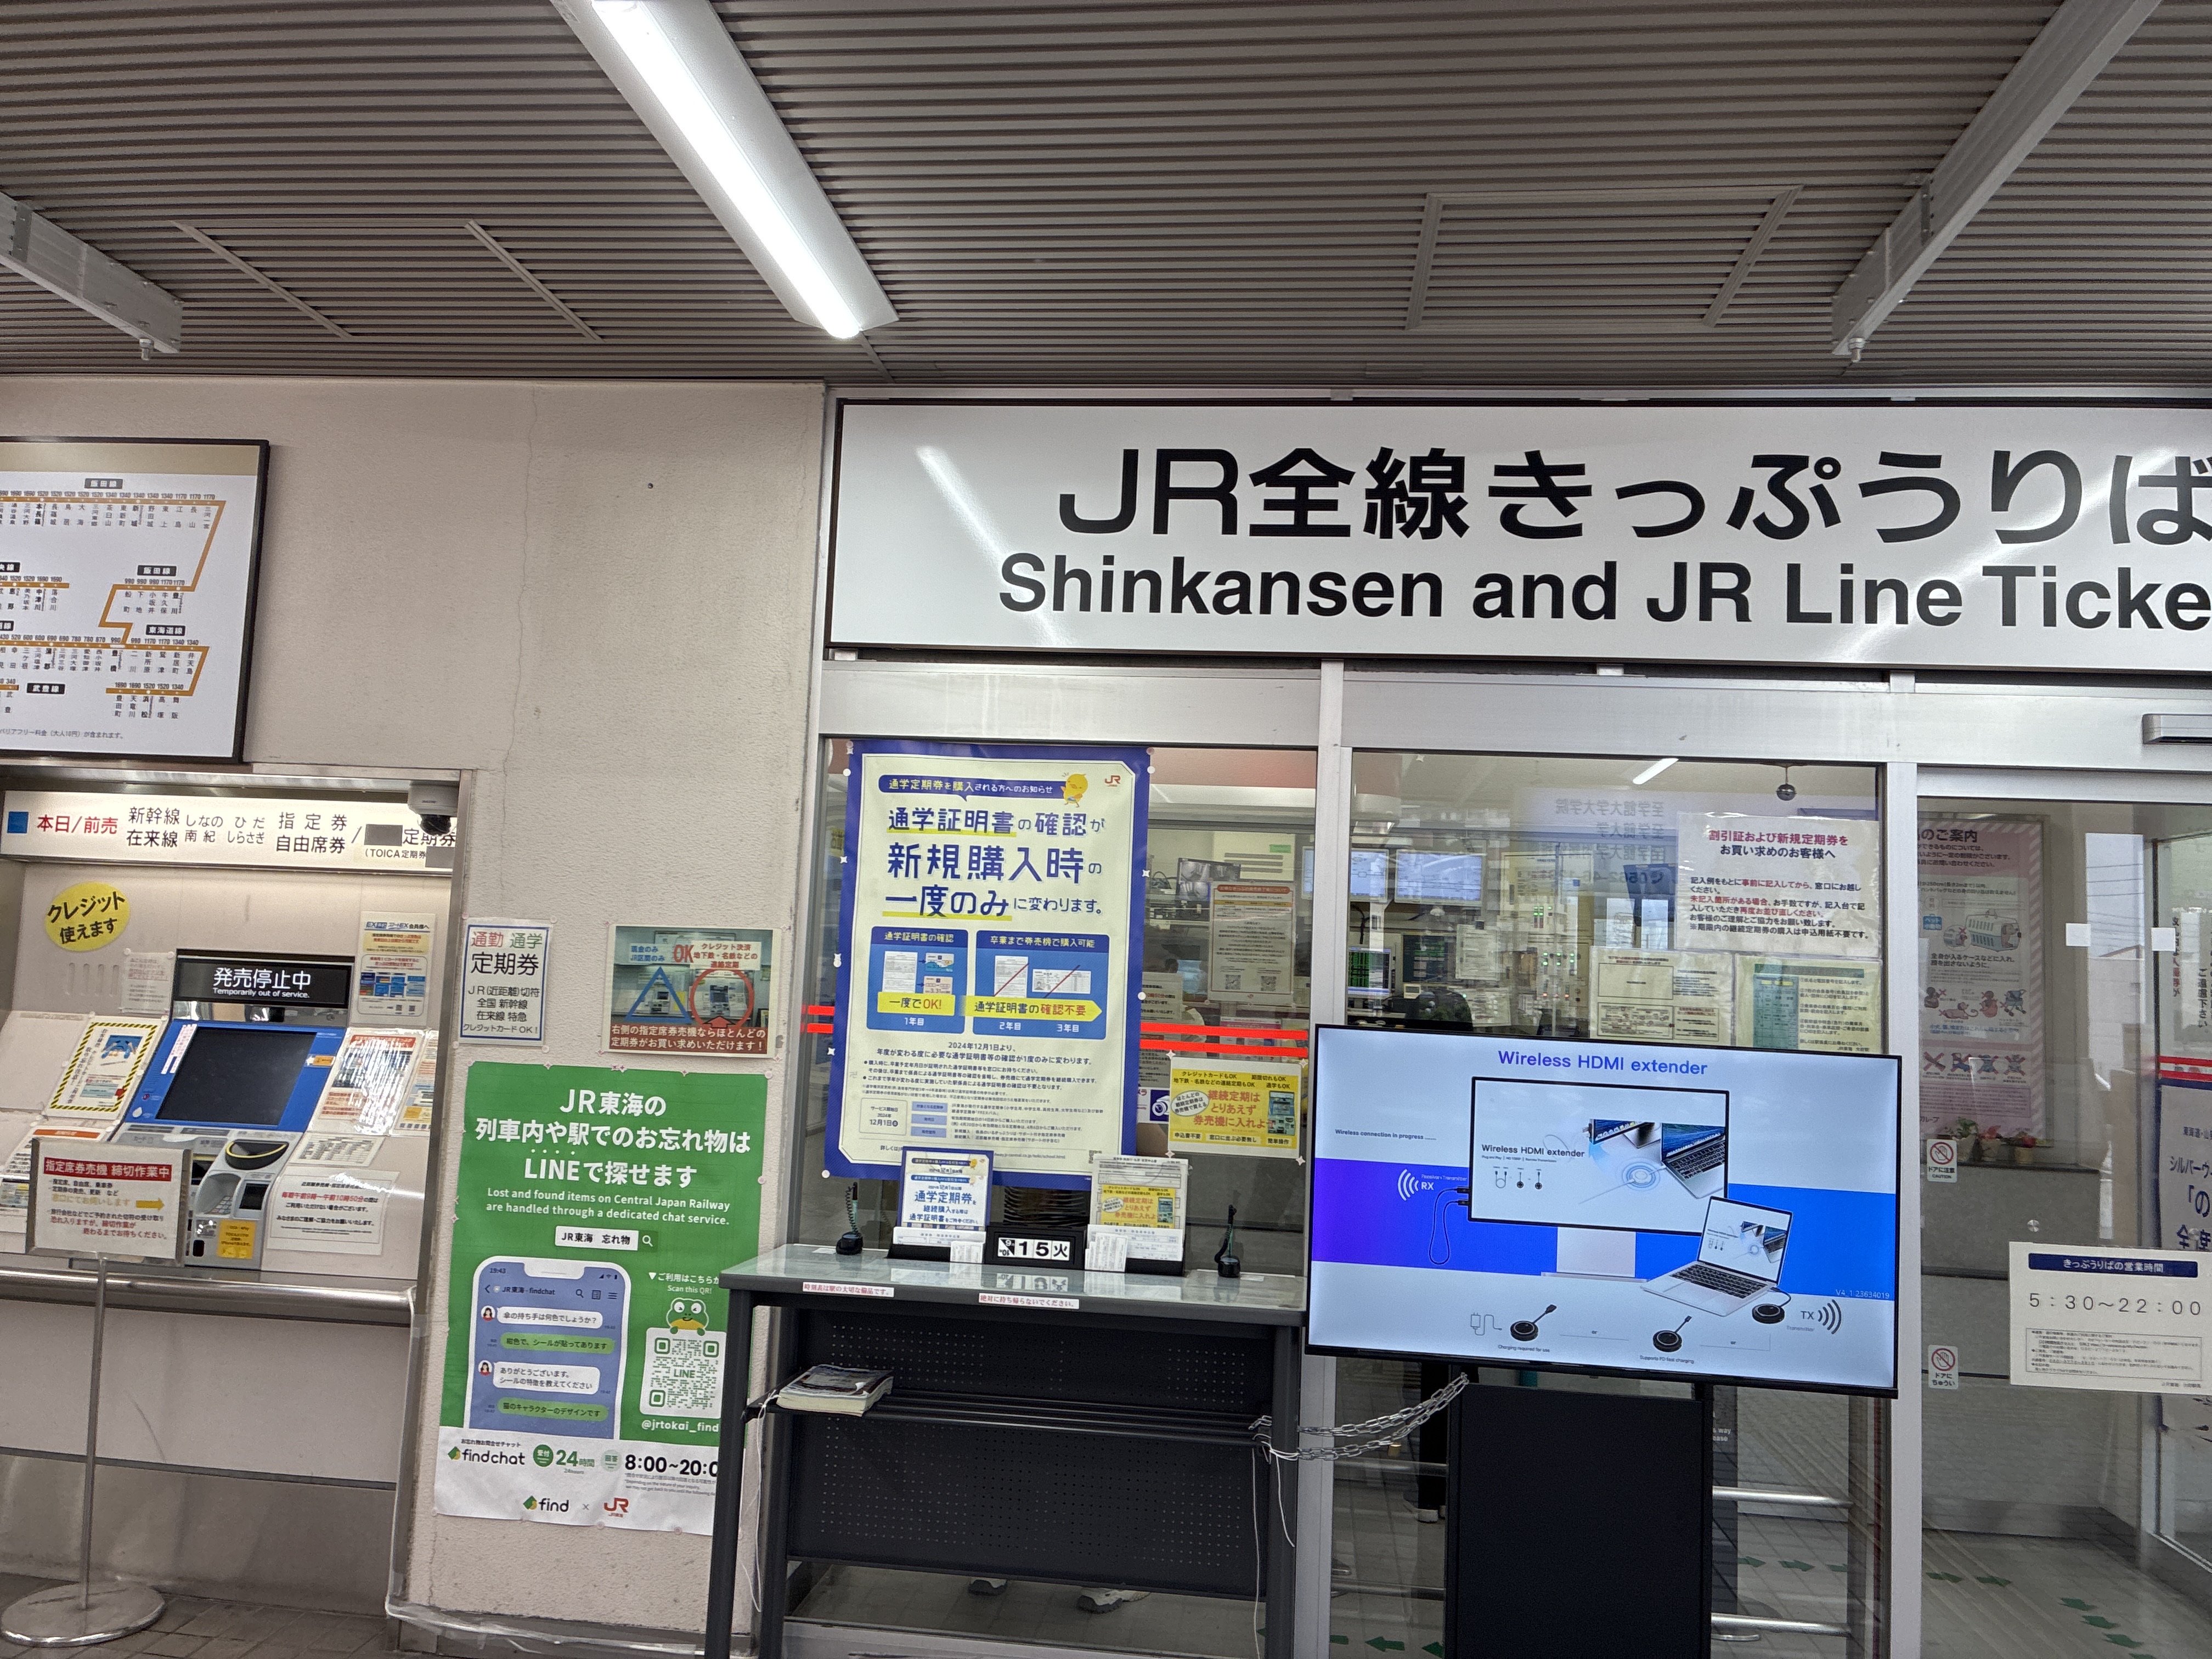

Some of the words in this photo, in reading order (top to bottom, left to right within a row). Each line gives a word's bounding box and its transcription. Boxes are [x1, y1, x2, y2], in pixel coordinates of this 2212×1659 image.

[1059, 447, 2212, 545] JR全線きっぷうりば
[999, 552, 1443, 617] Shinkansen
[1472, 560, 1617, 621] and
[1646, 561, 1752, 623] JR
[1786, 563, 1963, 627] Line
[1982, 565, 2212, 631] Ticke
[888, 777, 1053, 795] 通学定期券を購入される方へのお知らせ
[128, 806, 180, 826] 新幹線
[185, 814, 224, 828] しなの
[278, 811, 348, 832] 指定券
[888, 806, 1106, 837] 通学証明書の確認が
[126, 829, 178, 849] 在来線
[184, 830, 216, 843] 南紀
[226, 830, 266, 845] しらさぎ
[275, 833, 347, 855] 自由席券
[1708, 830, 1849, 847] 割引証および新規定期券を
[1918, 828, 1978, 843] のご案内
[1720, 844, 1836, 860] お買い求めのお客様へ
[887, 841, 1103, 885] 新規購入時の
[46, 890, 126, 924] クレジット
[884, 883, 1103, 918] 一度のみに変わります。
[60, 917, 119, 945] 使えます
[470, 930, 504, 948] 通勤
[509, 932, 543, 949] 通学
[884, 931, 955, 944] 通学証明書の確認
[990, 935, 1096, 949] 卒業まで券売機で購入可能
[673, 944, 695, 963] OK
[701, 943, 752, 952] クレジット決済
[470, 951, 540, 977] 定期券
[212, 967, 312, 991] 発売停止中
[212, 987, 256, 997] Temporarily
[273, 990, 280, 998] of
[282, 991, 311, 999] service.
[477, 997, 496, 1008] 全国
[498, 998, 528, 1010] 新幹線
[974, 1001, 1086, 1017] 通学証明書の確認不要
[476, 1010, 506, 1022] 在来線
[507, 1011, 528, 1023] 特急
[904, 1017, 925, 1026] 1年目
[463, 1023, 517, 1034] クレジットカード
[611, 1024, 766, 1039] 右側の指定席券売機ならほとんどの
[998, 1021, 1022, 1031] 2年目
[1057, 1023, 1080, 1033] 3年目
[1498, 1050, 1572, 1069] Wireless
[1577, 1054, 1624, 1071] HDMI
[1630, 1059, 1708, 1076] extender
[558, 1088, 667, 1117] JR東海の
[1207, 1090, 1261, 1103] 継続定期は
[1210, 1103, 1257, 1115] とりあえず
[474, 1117, 752, 1154] 列車内や駅でのお忘れ物は
[1481, 1144, 1518, 1154] Wireless
[1521, 1146, 1544, 1155] HDMI
[1547, 1149, 1585, 1158] extender
[44, 1159, 109, 1176] 指定席券売機
[111, 1164, 170, 1178] 締切作業中
[523, 1158, 698, 1189] LINEで探せます
[1420, 1181, 1435, 1191] RX
[487, 1186, 510, 1198] Lost
[511, 1188, 532, 1200] and
[533, 1189, 566, 1201] found
[567, 1190, 596, 1203] items
[597, 1195, 612, 1204] on
[613, 1193, 653, 1207] Central
[654, 1196, 687, 1210] Japan
[689, 1198, 731, 1213] Railway
[486, 1204, 504, 1212] are
[505, 1201, 550, 1215] handled
[551, 1204, 595, 1220] through
[597, 1209, 604, 1218] a
[606, 1206, 660, 1222] dedicated
[662, 1211, 686, 1222] chat
[687, 1213, 730, 1226] service.
[561, 1231, 594, 1244] JR東海
[601, 1233, 631, 1246] 忘れ物
[1053, 1243, 1068, 1258] 火
[2063, 1257, 2164, 1274] きっぷうりばの営業時間
[667, 1284, 685, 1293] Scan
[685, 1285, 699, 1294] this
[699, 1286, 713, 1295] QR!
[1800, 1310, 1815, 1321] TX
[500, 1367, 569, 1379] ありがとうございます。
[673, 1368, 696, 1379] LINE
[641, 1419, 720, 1434] @jrtokai_find
[461, 1448, 526, 1466] findchat
[538, 1497, 569, 1513] find
[603, 1497, 629, 1514] JR
